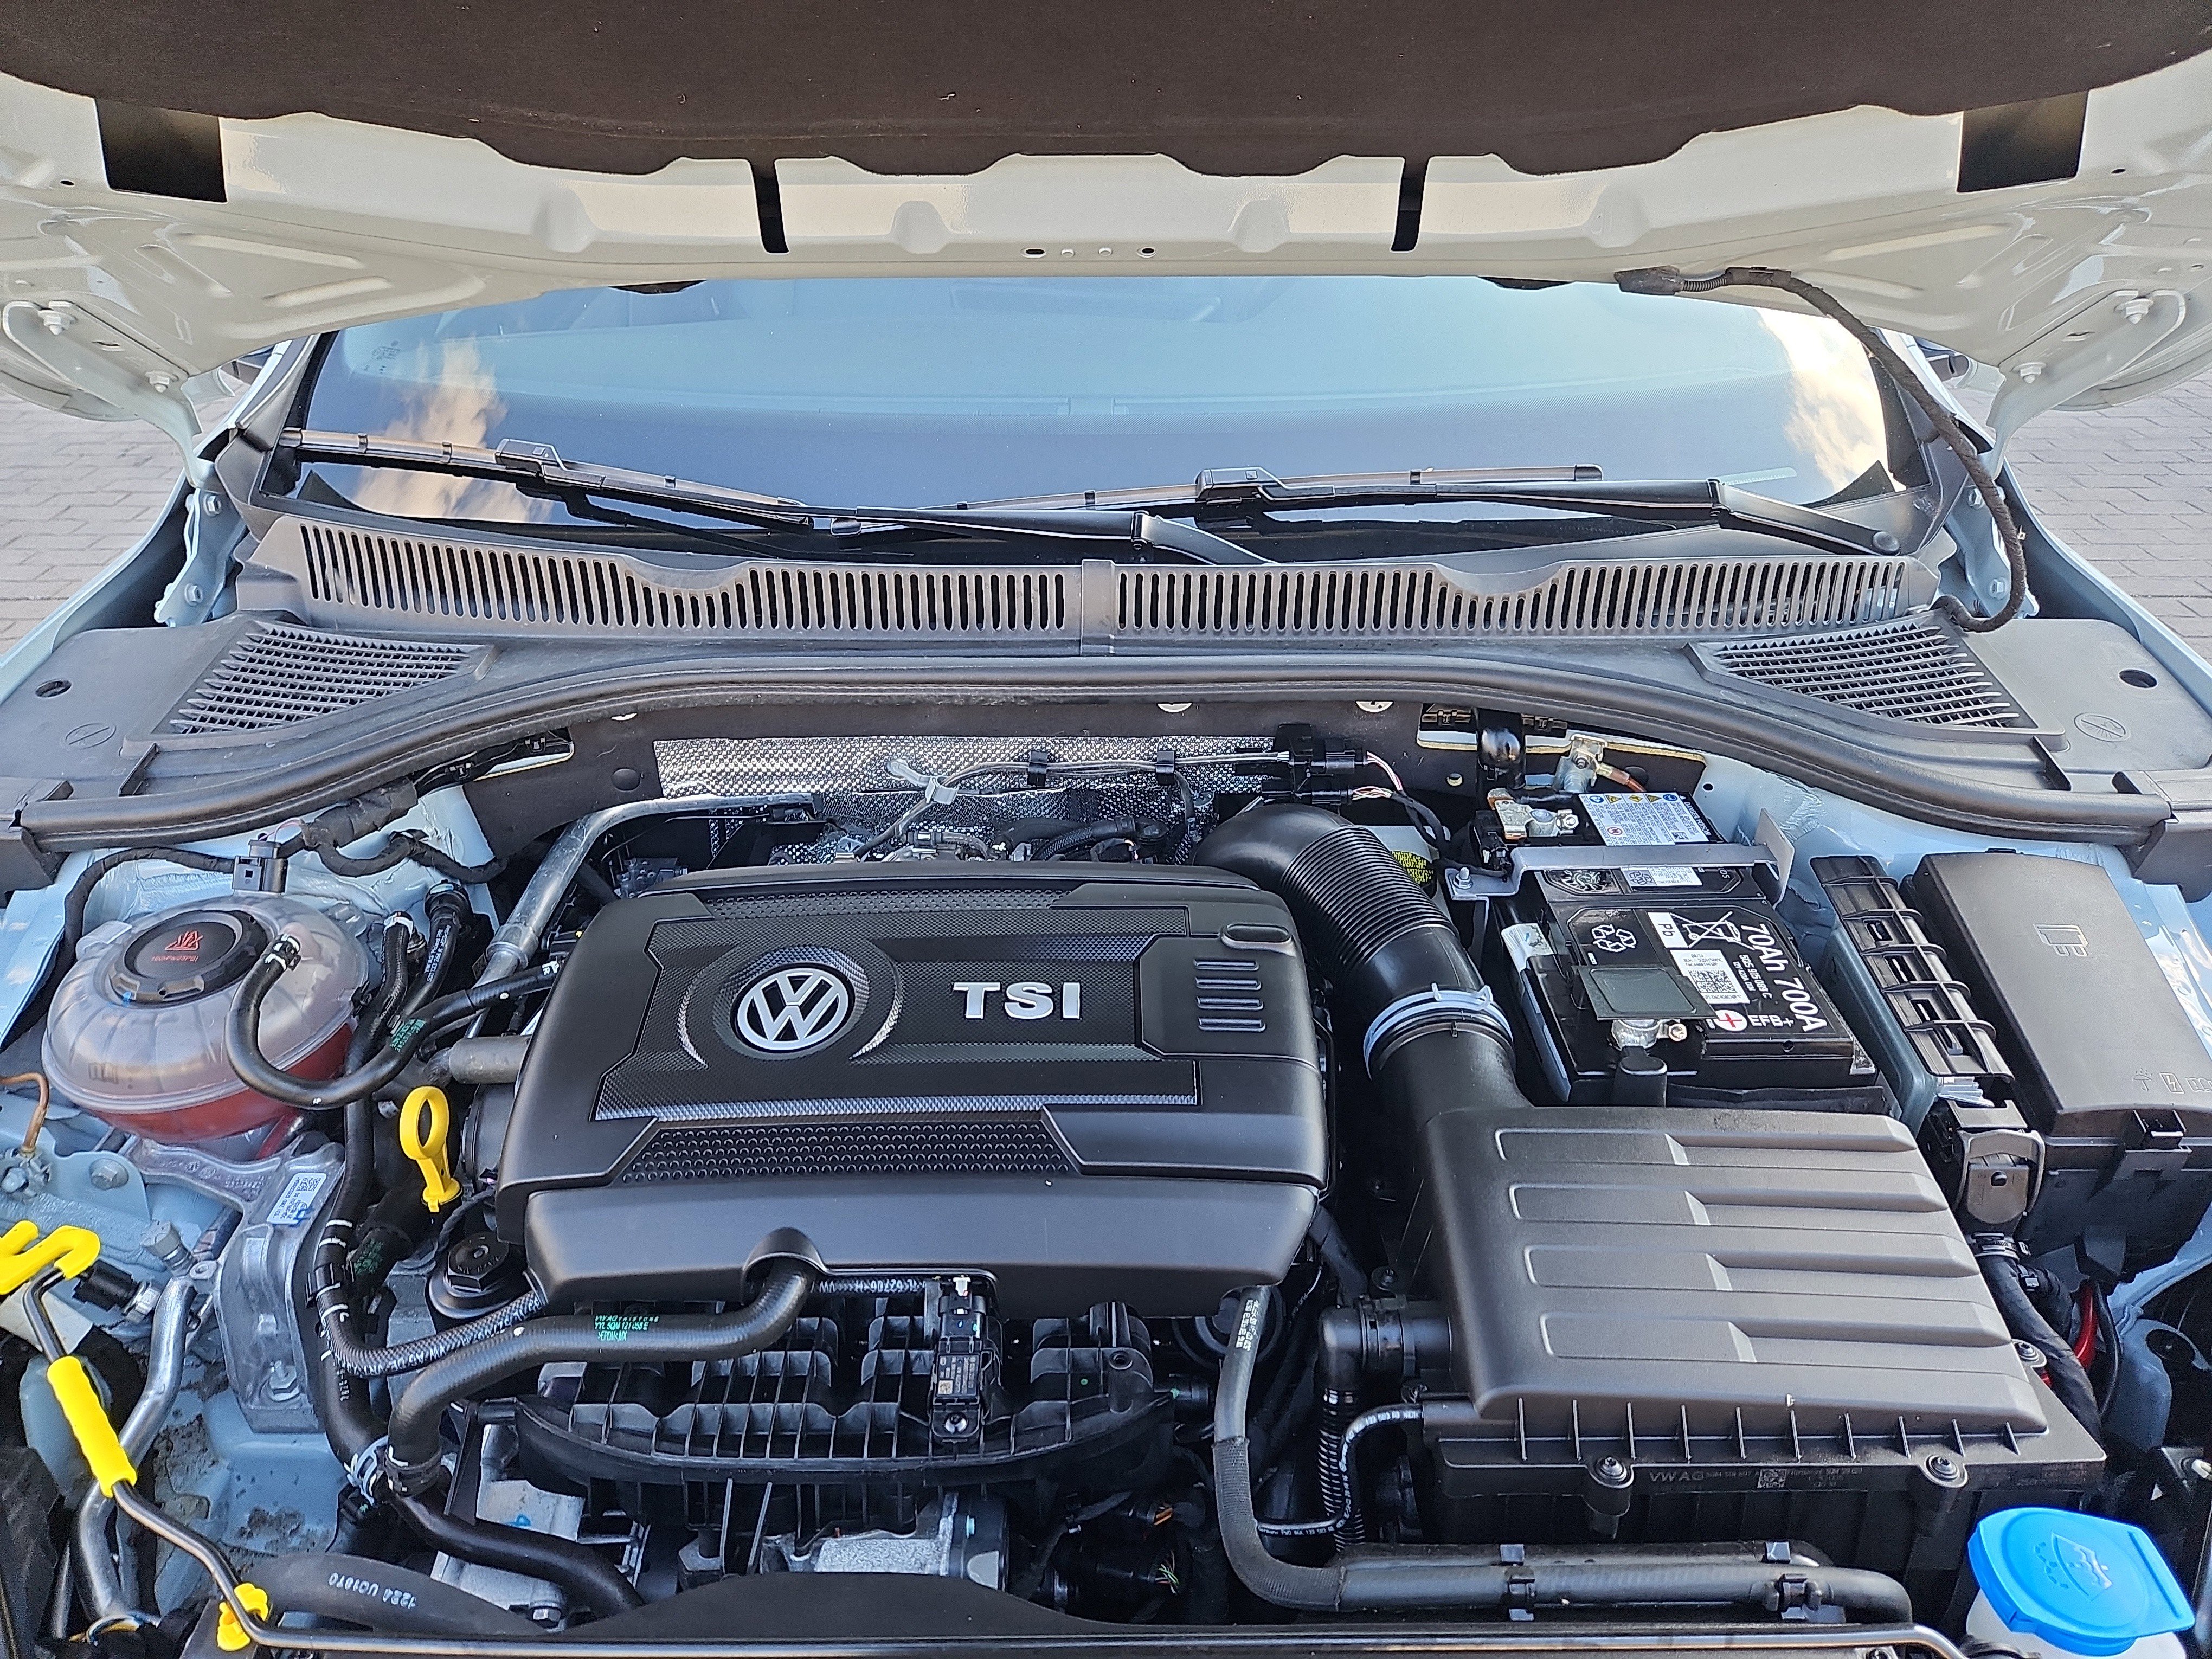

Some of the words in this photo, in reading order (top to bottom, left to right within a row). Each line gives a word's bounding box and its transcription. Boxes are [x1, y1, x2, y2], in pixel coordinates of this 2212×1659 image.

[1658, 923, 1675, 936] Pb
[1741, 923, 1788, 972] 70Ah
[1774, 977, 1827, 1032] 700A
[736, 966, 850, 1052] VW
[952, 981, 1081, 1020] TSI
[1748, 1015, 1795, 1027] EFB+
[1649, 1471, 1676, 1482] VW
[1679, 1471, 1704, 1482] AG
